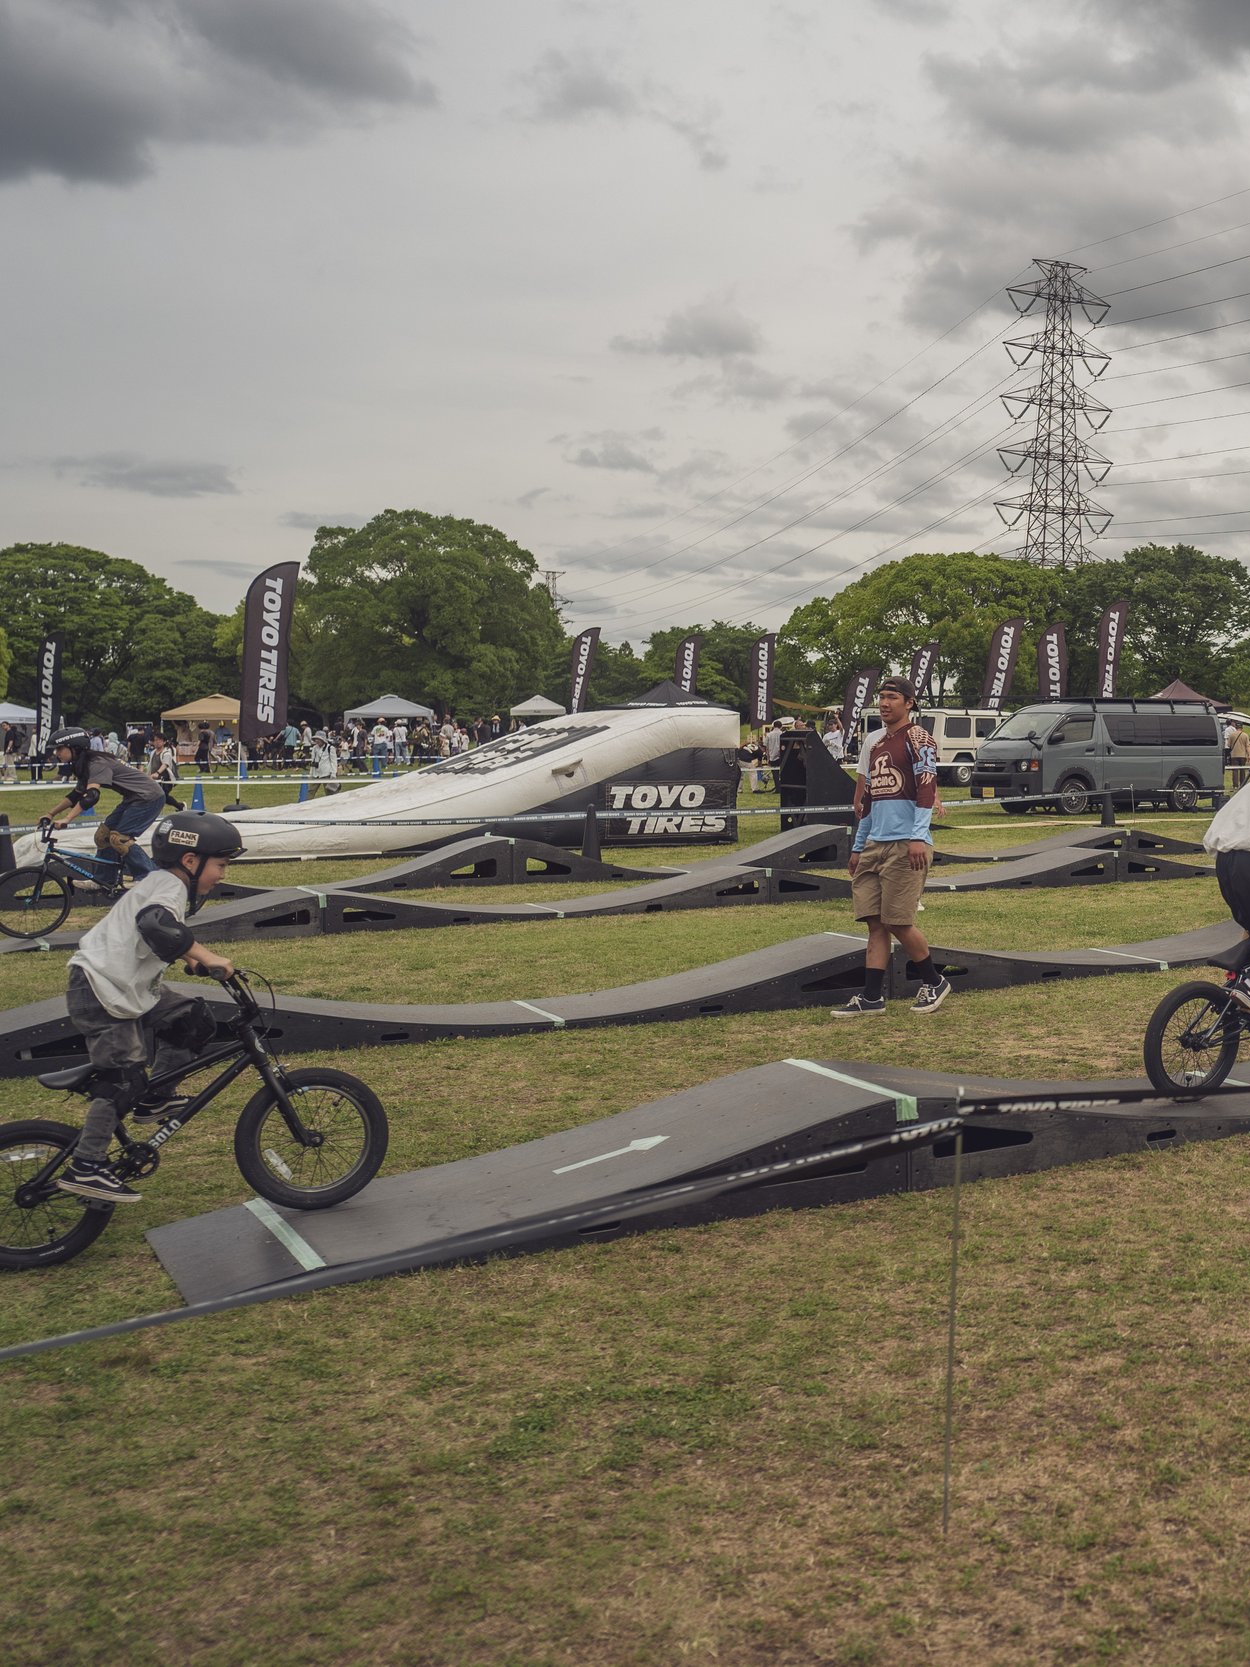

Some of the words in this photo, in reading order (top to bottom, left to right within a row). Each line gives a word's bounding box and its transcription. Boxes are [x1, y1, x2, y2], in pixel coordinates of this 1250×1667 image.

[261, 577, 284, 647] TOYO
[577, 635, 592, 676] TOYO
[997, 626, 1015, 671] TOYO
[1046, 633, 1061, 681] TOYO
[1106, 611, 1120, 662] TOYO
[41, 641, 57, 696] TOYO
[682, 641, 695, 680] TOYO
[758, 641, 769, 680] TOYO
[914, 650, 931, 688] TOYO
[256, 649, 278, 725] TIRES
[757, 680, 767, 721] TIRES
[988, 671, 1006, 709] TIRE
[37, 696, 53, 755] TIRES
[610, 784, 706, 809] TOYO
[170, 830, 197, 841] FRANK
[626, 815, 727, 834] TIRES
[148, 1119, 182, 1149] SOLO
